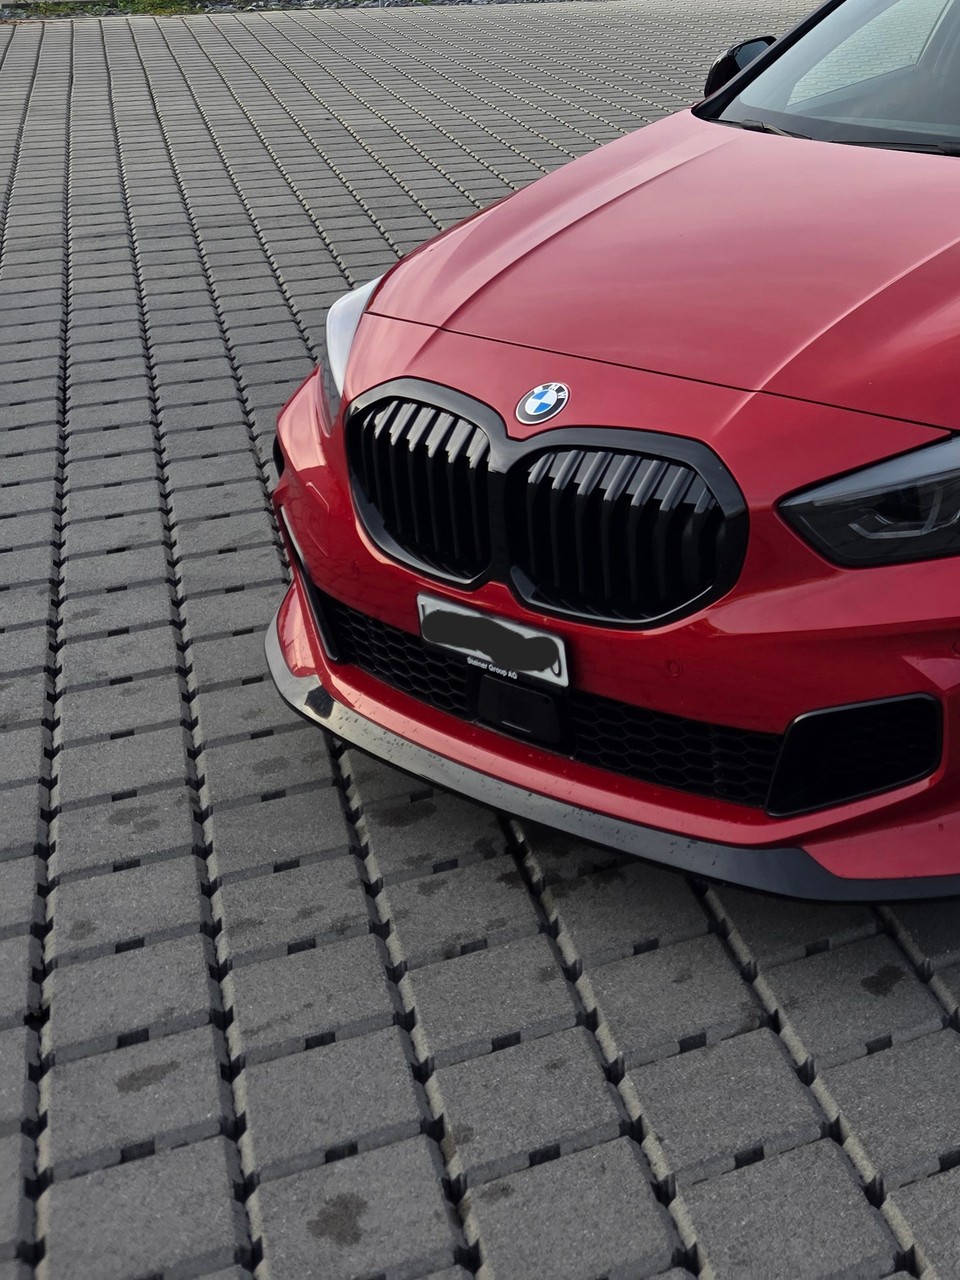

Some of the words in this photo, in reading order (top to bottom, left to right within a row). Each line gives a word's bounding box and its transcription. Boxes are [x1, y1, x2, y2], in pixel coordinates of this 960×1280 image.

[466, 656, 488, 670] Steiner
[488, 664, 508, 677] Group
[508, 671, 518, 680] AG
